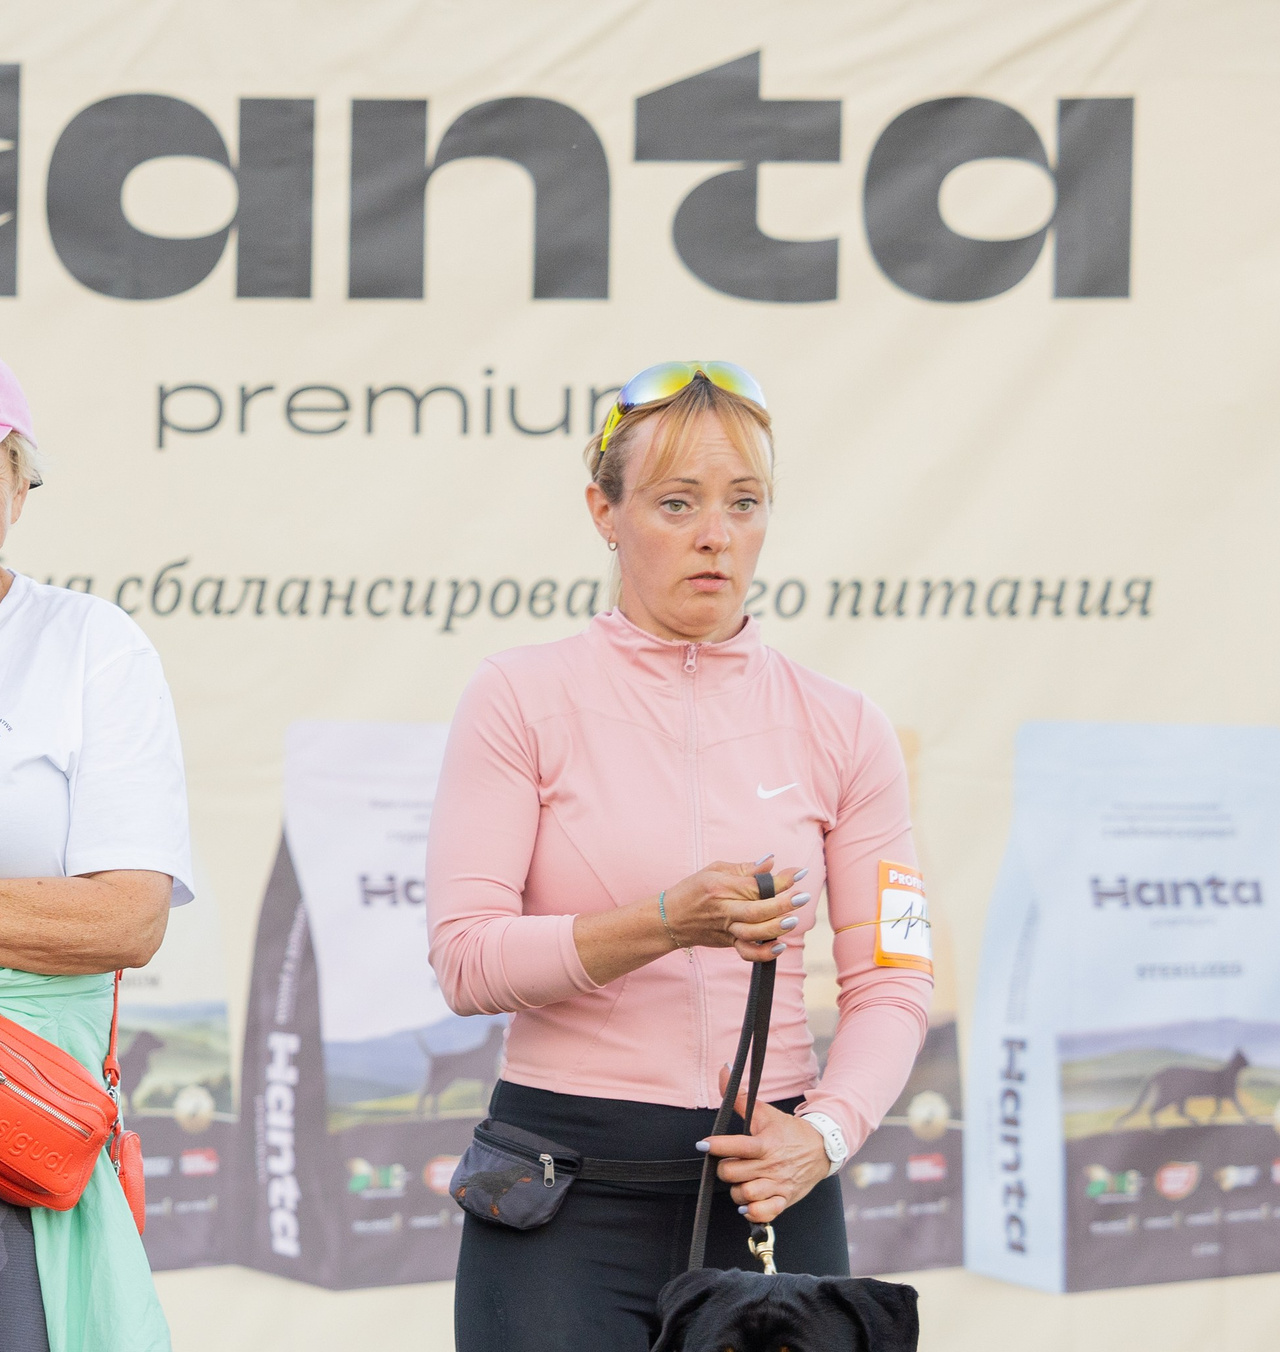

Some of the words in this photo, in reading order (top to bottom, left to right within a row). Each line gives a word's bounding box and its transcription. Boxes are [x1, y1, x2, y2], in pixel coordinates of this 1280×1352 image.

[826, 571, 1157, 621] питания
[1090, 873, 1264, 908] Hanta
[265, 1030, 303, 1258] Hanta
[999, 1035, 1029, 1256] Hanta
